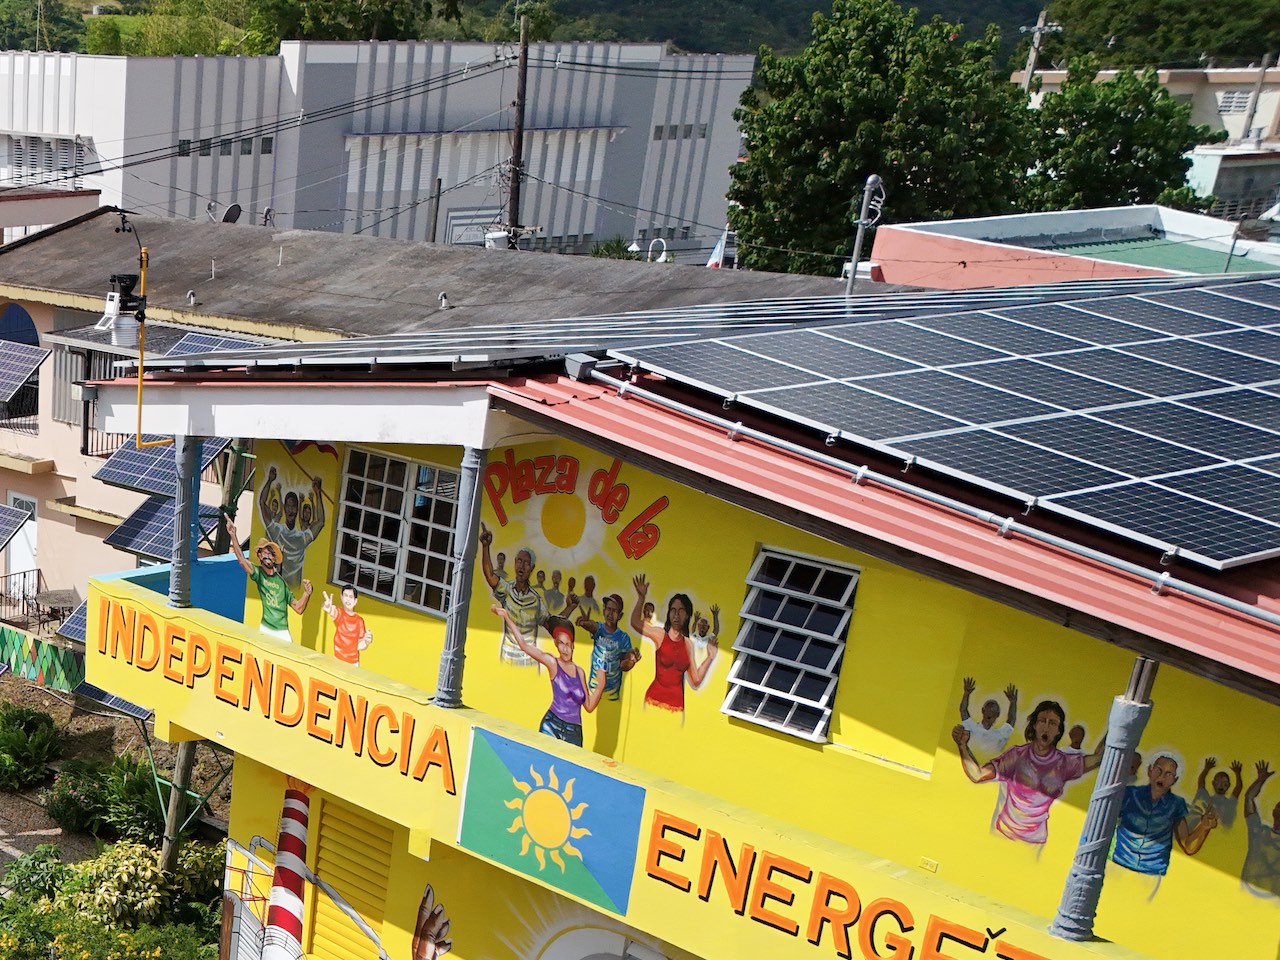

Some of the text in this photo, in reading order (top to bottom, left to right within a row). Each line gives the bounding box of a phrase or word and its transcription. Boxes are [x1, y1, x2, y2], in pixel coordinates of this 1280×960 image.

[482, 448, 670, 560] Plaza de la
[98, 596, 457, 796] INDEPENDENCIA
